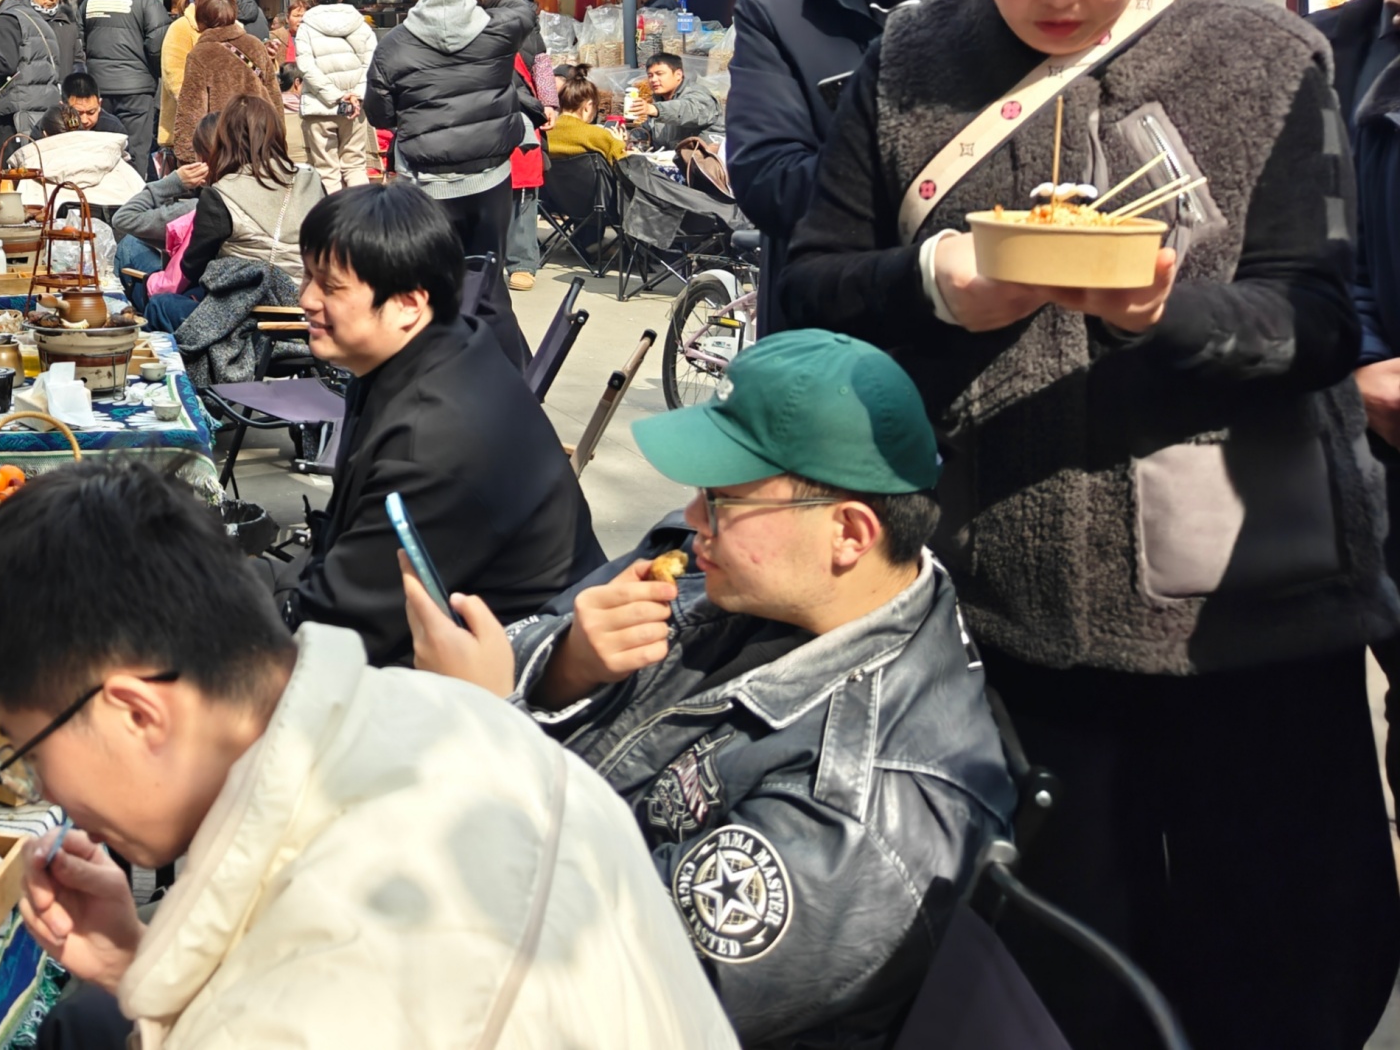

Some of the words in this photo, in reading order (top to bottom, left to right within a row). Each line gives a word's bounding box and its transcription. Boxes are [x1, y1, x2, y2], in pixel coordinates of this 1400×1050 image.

[677, 860, 697, 909] CAGE
[688, 910, 741, 956] TESTED
[718, 831, 754, 855] MMA
[753, 848, 784, 927] MASTER
